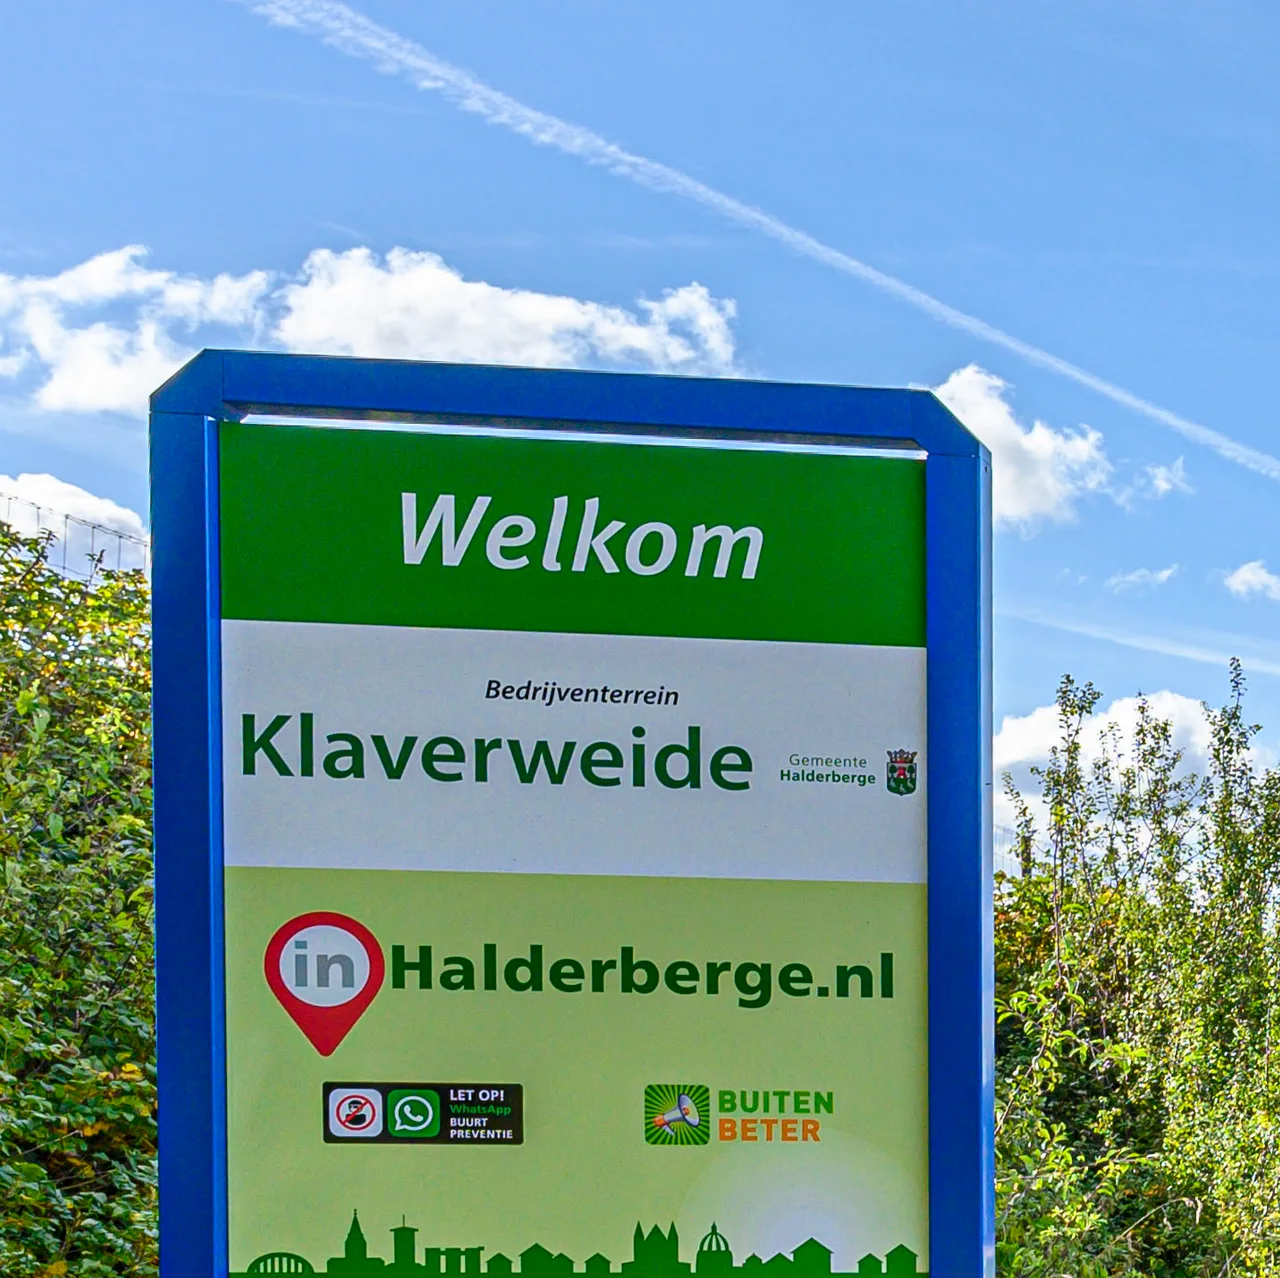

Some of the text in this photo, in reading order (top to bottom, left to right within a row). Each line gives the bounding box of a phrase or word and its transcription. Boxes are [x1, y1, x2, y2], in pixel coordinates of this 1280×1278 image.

[399, 491, 765, 581] Welkom
[484, 677, 680, 708] Bedrijventerrein
[240, 711, 755, 792] Klaverweide
[789, 753, 868, 768] Gemeente
[780, 769, 877, 787] Halderberge
[292, 939, 896, 1009] in Halderberge.nl
[449, 1089, 505, 1102] LET OP!
[718, 1090, 834, 1114] BUITEN
[449, 1104, 512, 1117] WhatsApp
[449, 1117, 489, 1128] BUURT
[718, 1118, 821, 1142] BETER
[449, 1128, 514, 1140] PREVENTIE
